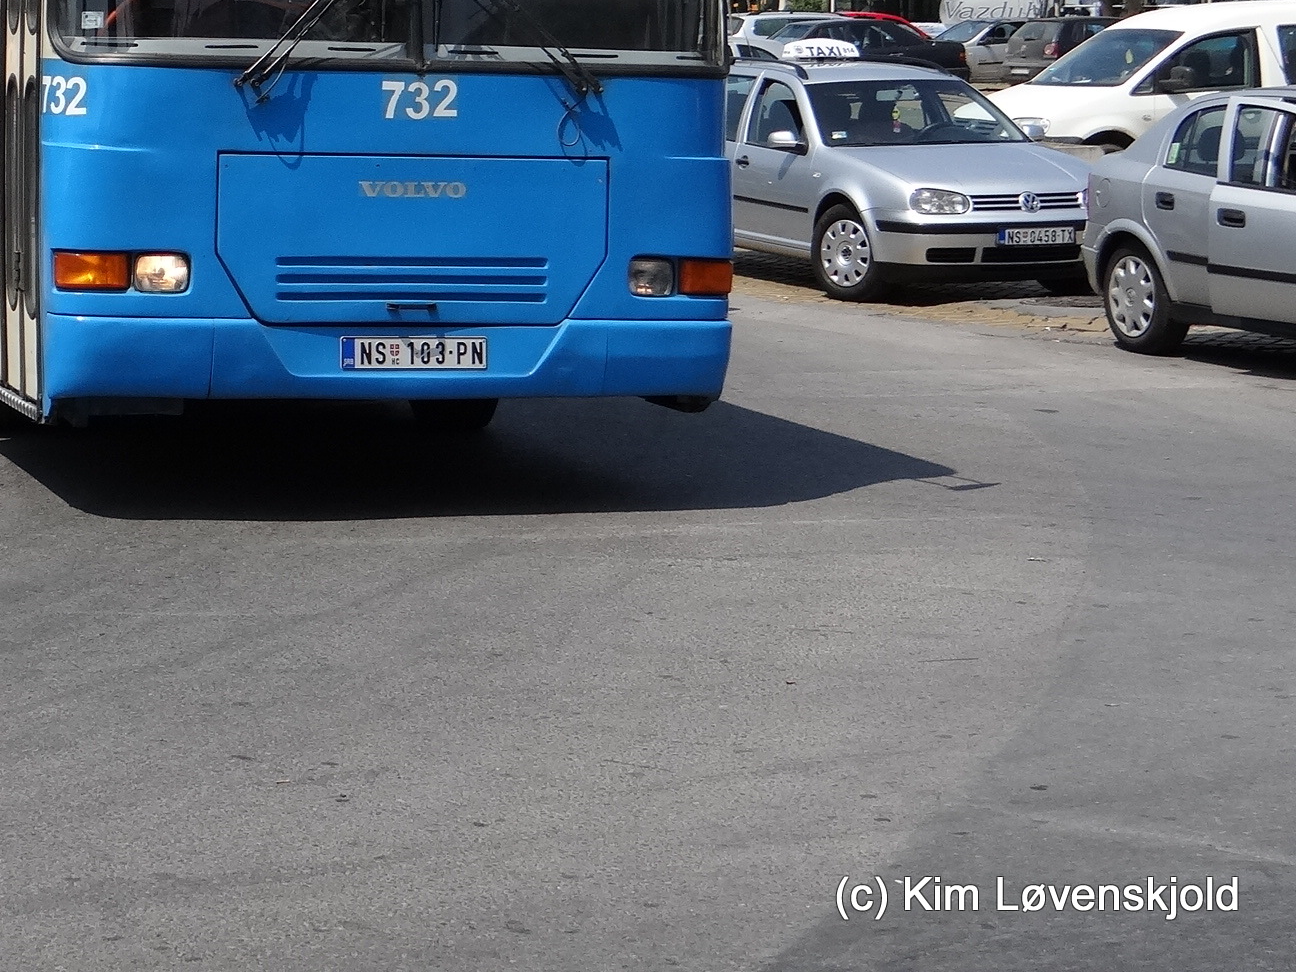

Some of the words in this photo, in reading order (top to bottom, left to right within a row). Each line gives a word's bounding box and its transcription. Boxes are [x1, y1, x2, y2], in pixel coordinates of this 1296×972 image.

[805, 46, 842, 57] TAXI
[42, 75, 87, 116] 732
[381, 79, 458, 120] 732
[358, 181, 467, 198] VOLVO
[1007, 230, 1021, 244] NS
[359, 341, 386, 365] NS
